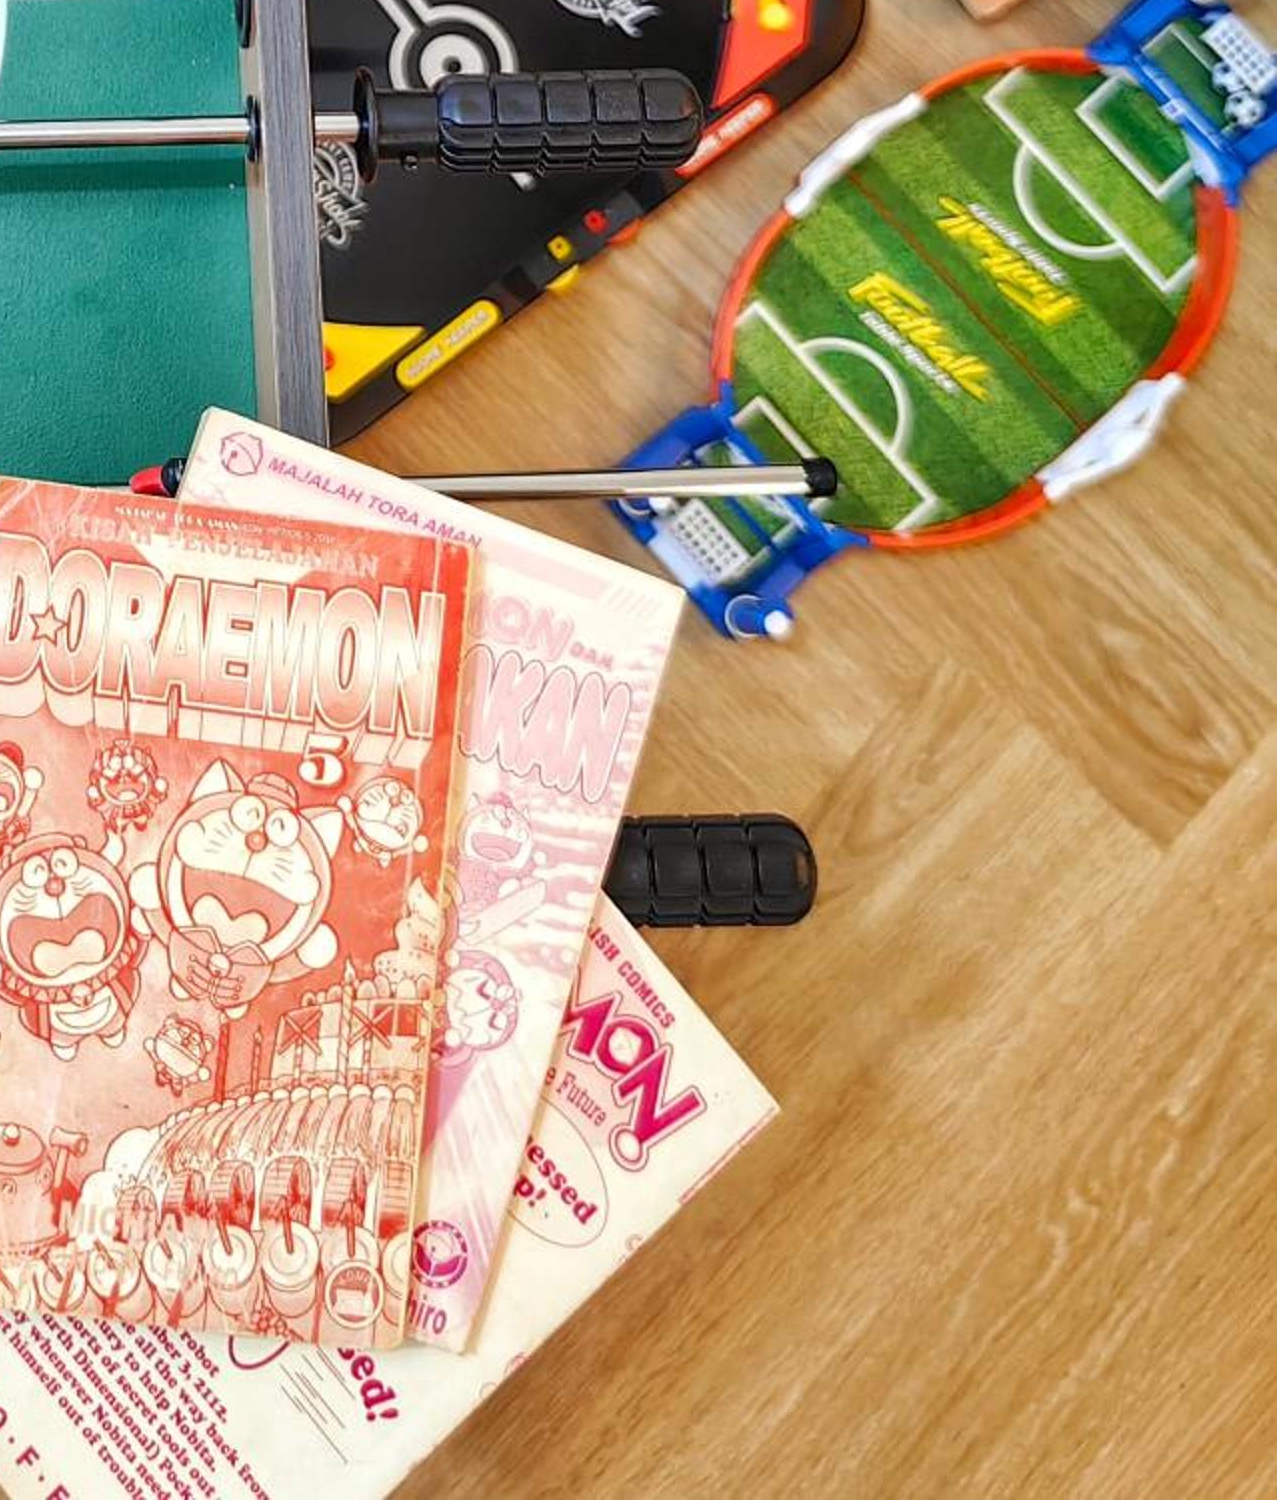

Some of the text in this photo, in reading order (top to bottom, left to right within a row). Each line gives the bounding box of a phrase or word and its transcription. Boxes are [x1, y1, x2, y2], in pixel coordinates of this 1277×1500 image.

[268, 457, 483, 549] MAJALAH TORA AMAN
[299, 733, 350, 787] 5
[617, 960, 676, 1028] COMICS
[555, 1071, 607, 1127] Future
[526, 1136, 598, 1225] essed
[9, 1332, 63, 1397] himself
[58, 1395, 85, 1426] out
[82, 1426, 102, 1447] of
[30, 1325, 93, 1406] whenever
[92, 1403, 138, 1464] Nobita
[94, 1317, 216, 1473] ury to help Nobita.
[179, 1360, 193, 1380] 3,
[193, 1378, 228, 1424] 2112.
[180, 1329, 220, 1378] robot
[73, 1348, 161, 1461] Dimensional)
[101, 1355, 121, 1374] of
[116, 1375, 158, 1425] secret
[156, 1424, 191, 1467] tools
[189, 1467, 217, 1498] out
[134, 1335, 157, 1360] all
[155, 1358, 178, 1388] the
[179, 1388, 207, 1424] way
[206, 1422, 240, 1468] back
[15, 1445, 41, 1468] F
